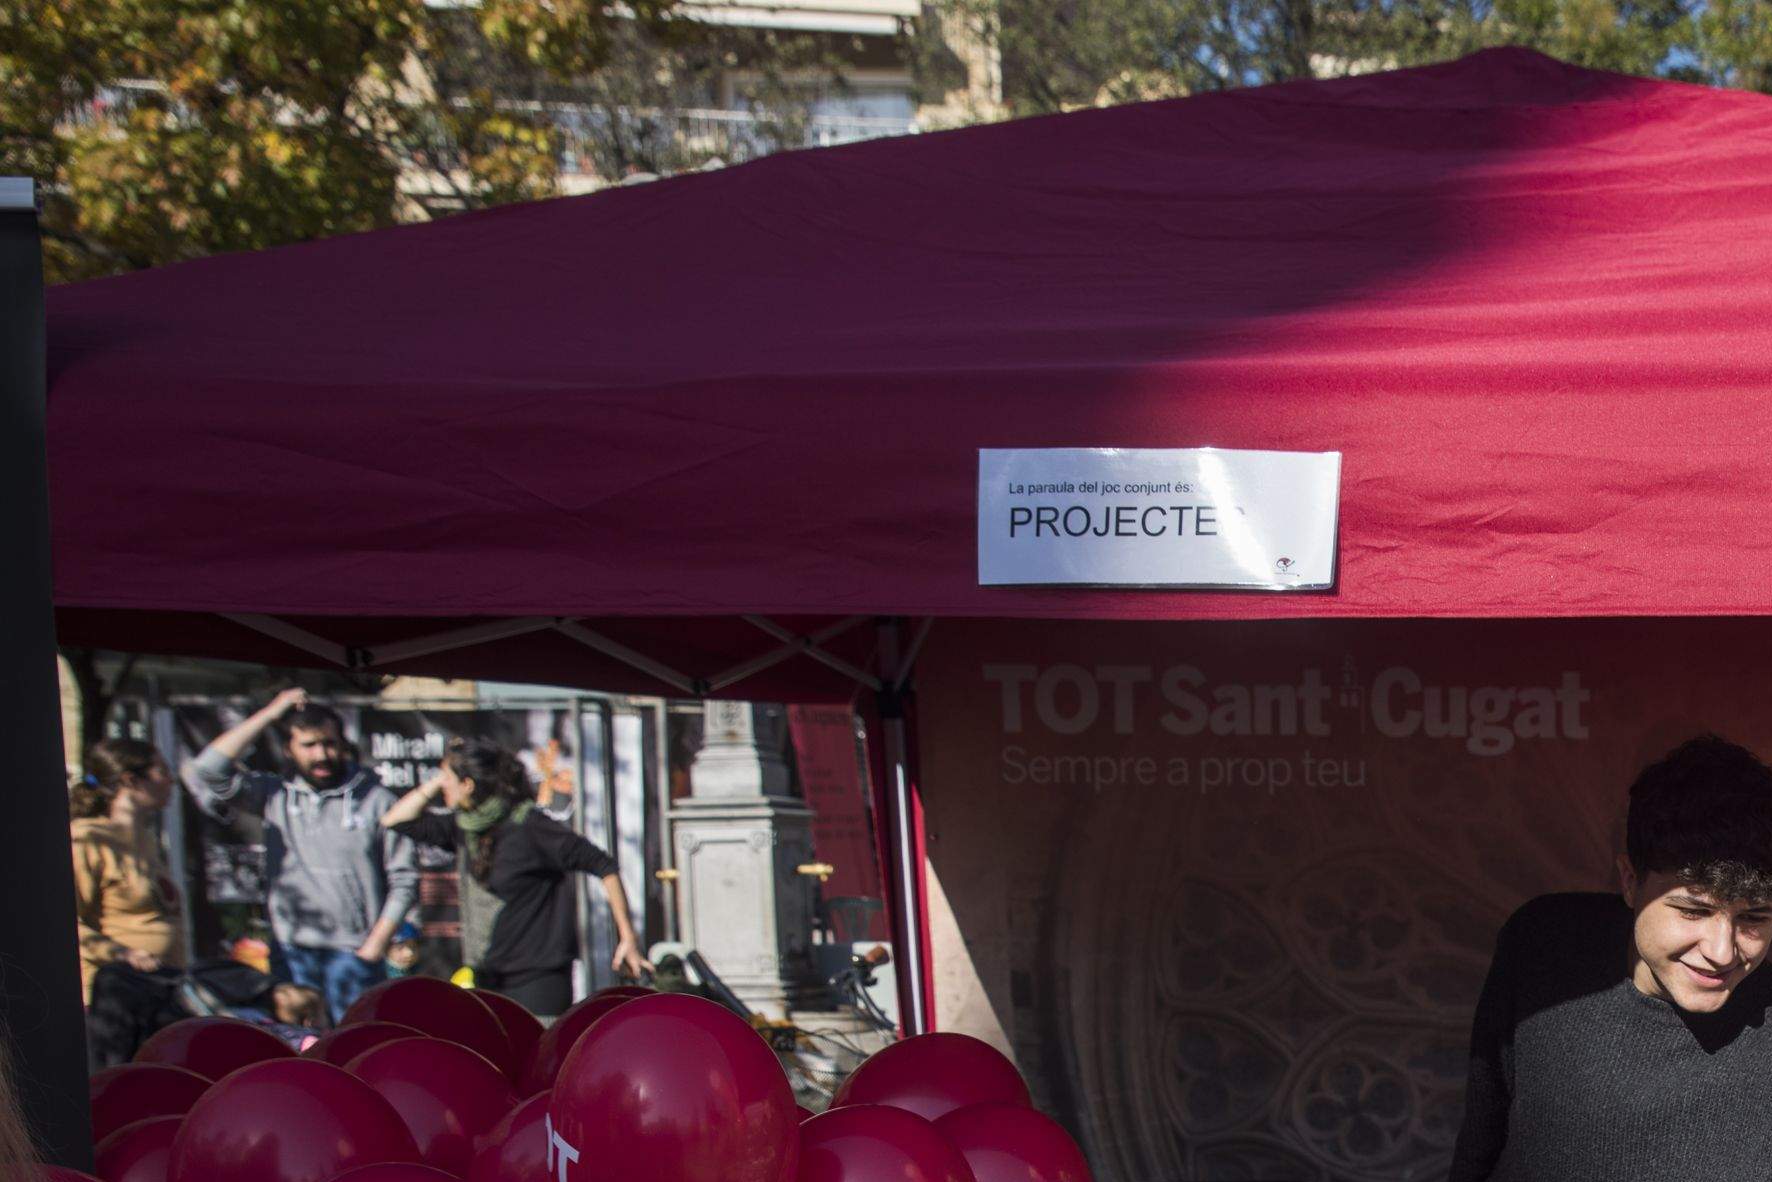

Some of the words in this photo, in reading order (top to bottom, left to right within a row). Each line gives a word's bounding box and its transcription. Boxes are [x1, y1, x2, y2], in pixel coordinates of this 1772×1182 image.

[1008, 482, 1025, 494] La
[1028, 481, 1076, 496] paraula
[1078, 481, 1098, 494] del
[1100, 481, 1121, 496] joc
[1124, 481, 1172, 496] conjunt
[1009, 505, 1246, 538] PROJECTE
[982, 664, 1154, 734] TOT
[1160, 665, 1331, 739] Sant
[1369, 667, 1591, 756] Cugat
[1001, 749, 1156, 795] Sempre
[1167, 758, 1190, 786] a
[1200, 757, 1294, 796] prop
[1302, 753, 1367, 787] teu
